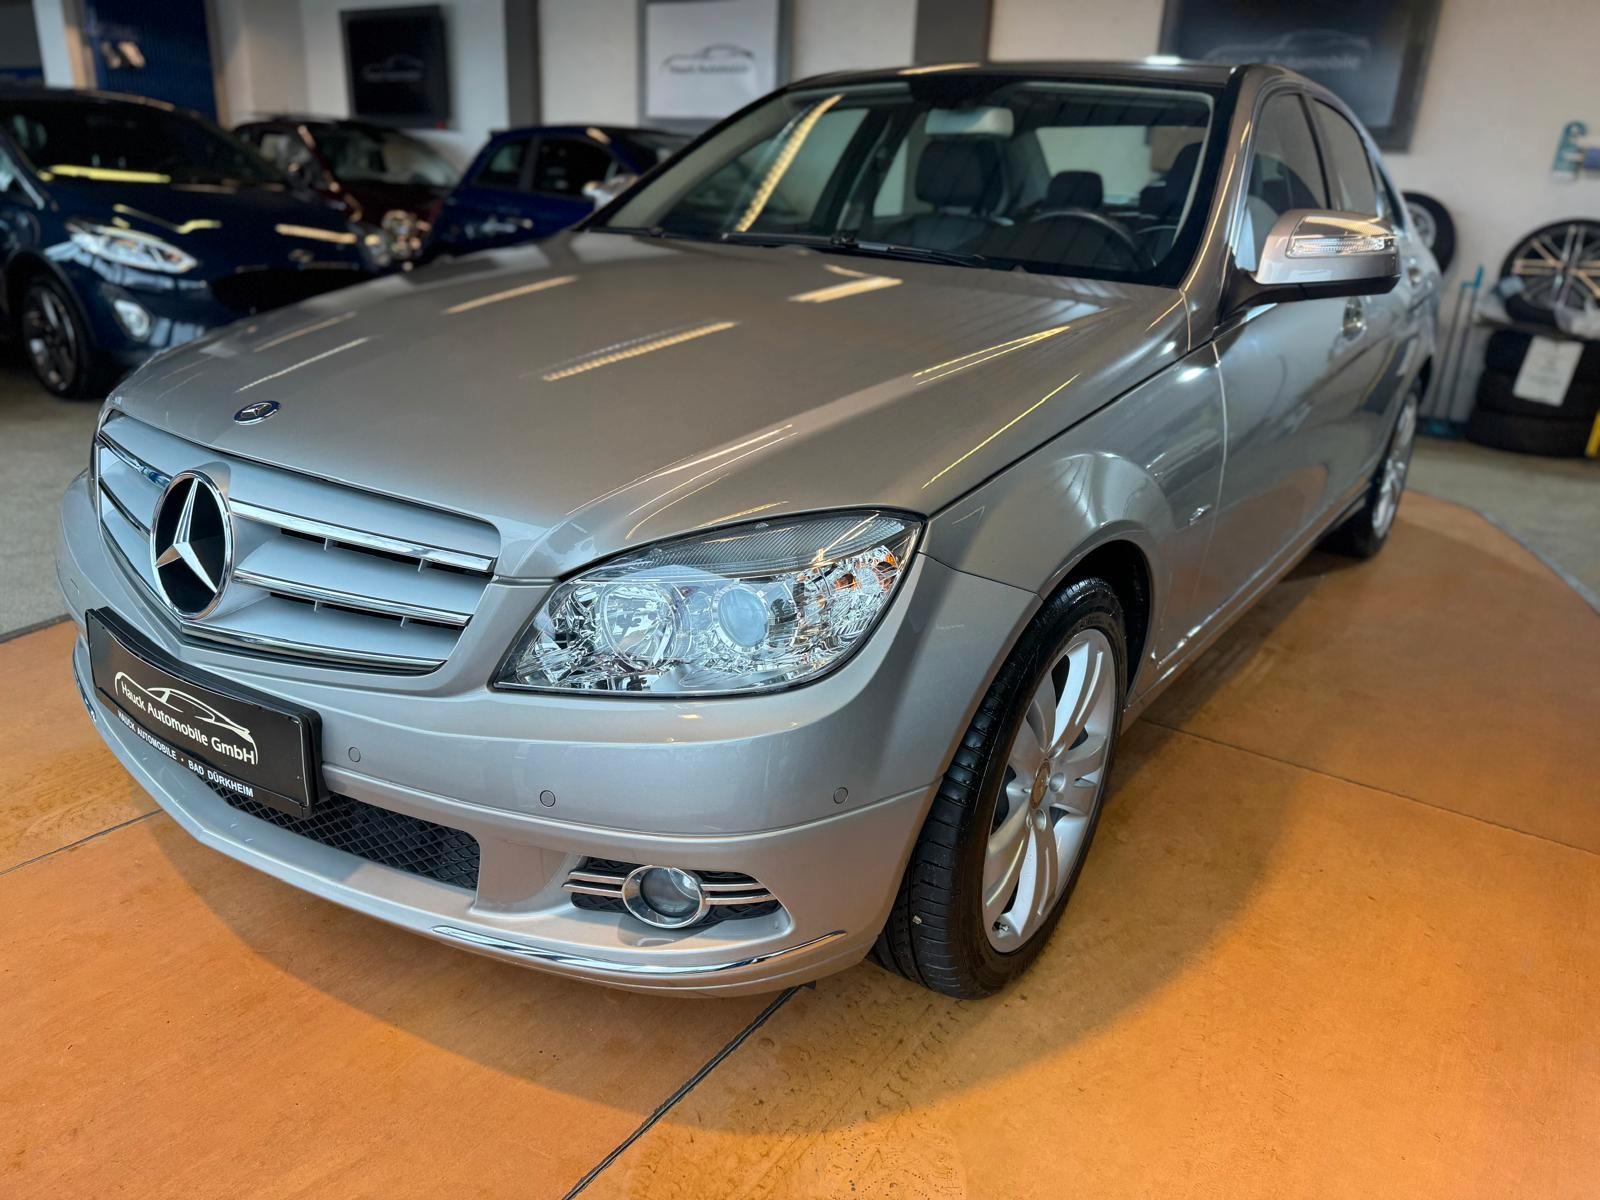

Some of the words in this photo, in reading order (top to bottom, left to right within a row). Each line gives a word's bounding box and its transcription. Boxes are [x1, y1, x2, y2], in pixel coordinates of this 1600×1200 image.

[117, 709, 136, 732] HAUCK
[137, 727, 177, 761] AUTOMOBILE
[188, 759, 204, 776] BAD
[207, 769, 253, 797] DÜRKHEIM
[121, 680, 146, 711] Hauck
[148, 702, 208, 746] Automobile
[211, 737, 255, 765] GmbH
